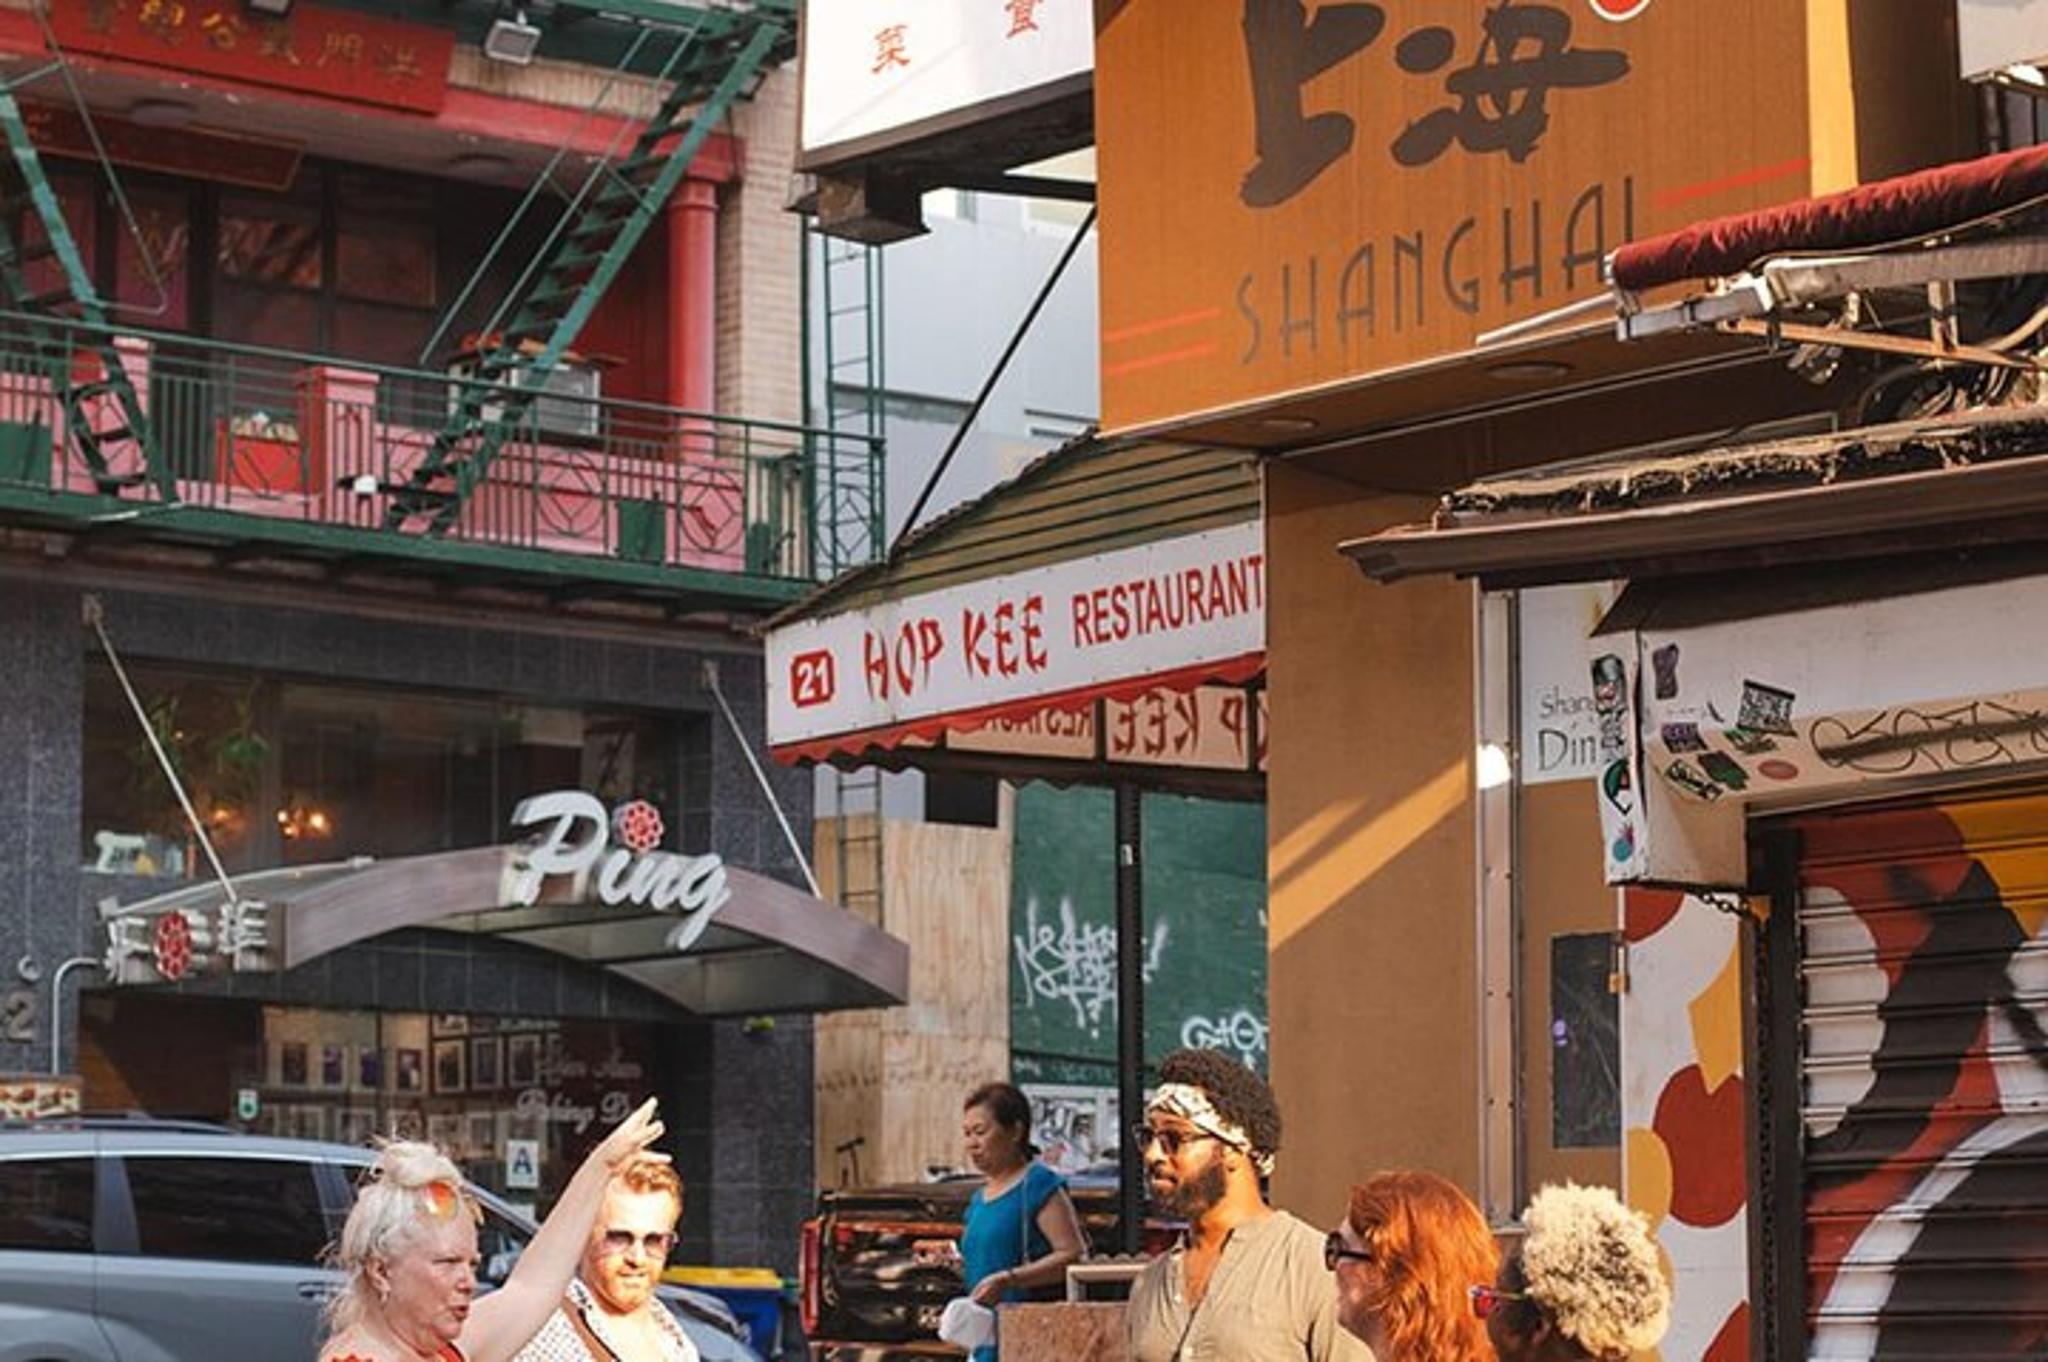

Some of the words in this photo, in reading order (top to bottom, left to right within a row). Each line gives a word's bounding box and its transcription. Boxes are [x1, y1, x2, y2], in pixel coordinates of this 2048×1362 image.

[1236, 175, 1635, 366] SHANGHAI
[796, 661, 830, 699] 21
[862, 616, 944, 700] HOP
[962, 595, 1048, 677] KEE
[1073, 554, 1265, 649] RESTAURANT
[1539, 685, 1596, 720] Shan
[510, 790, 731, 949] Ping
[512, 1147, 533, 1175] A
